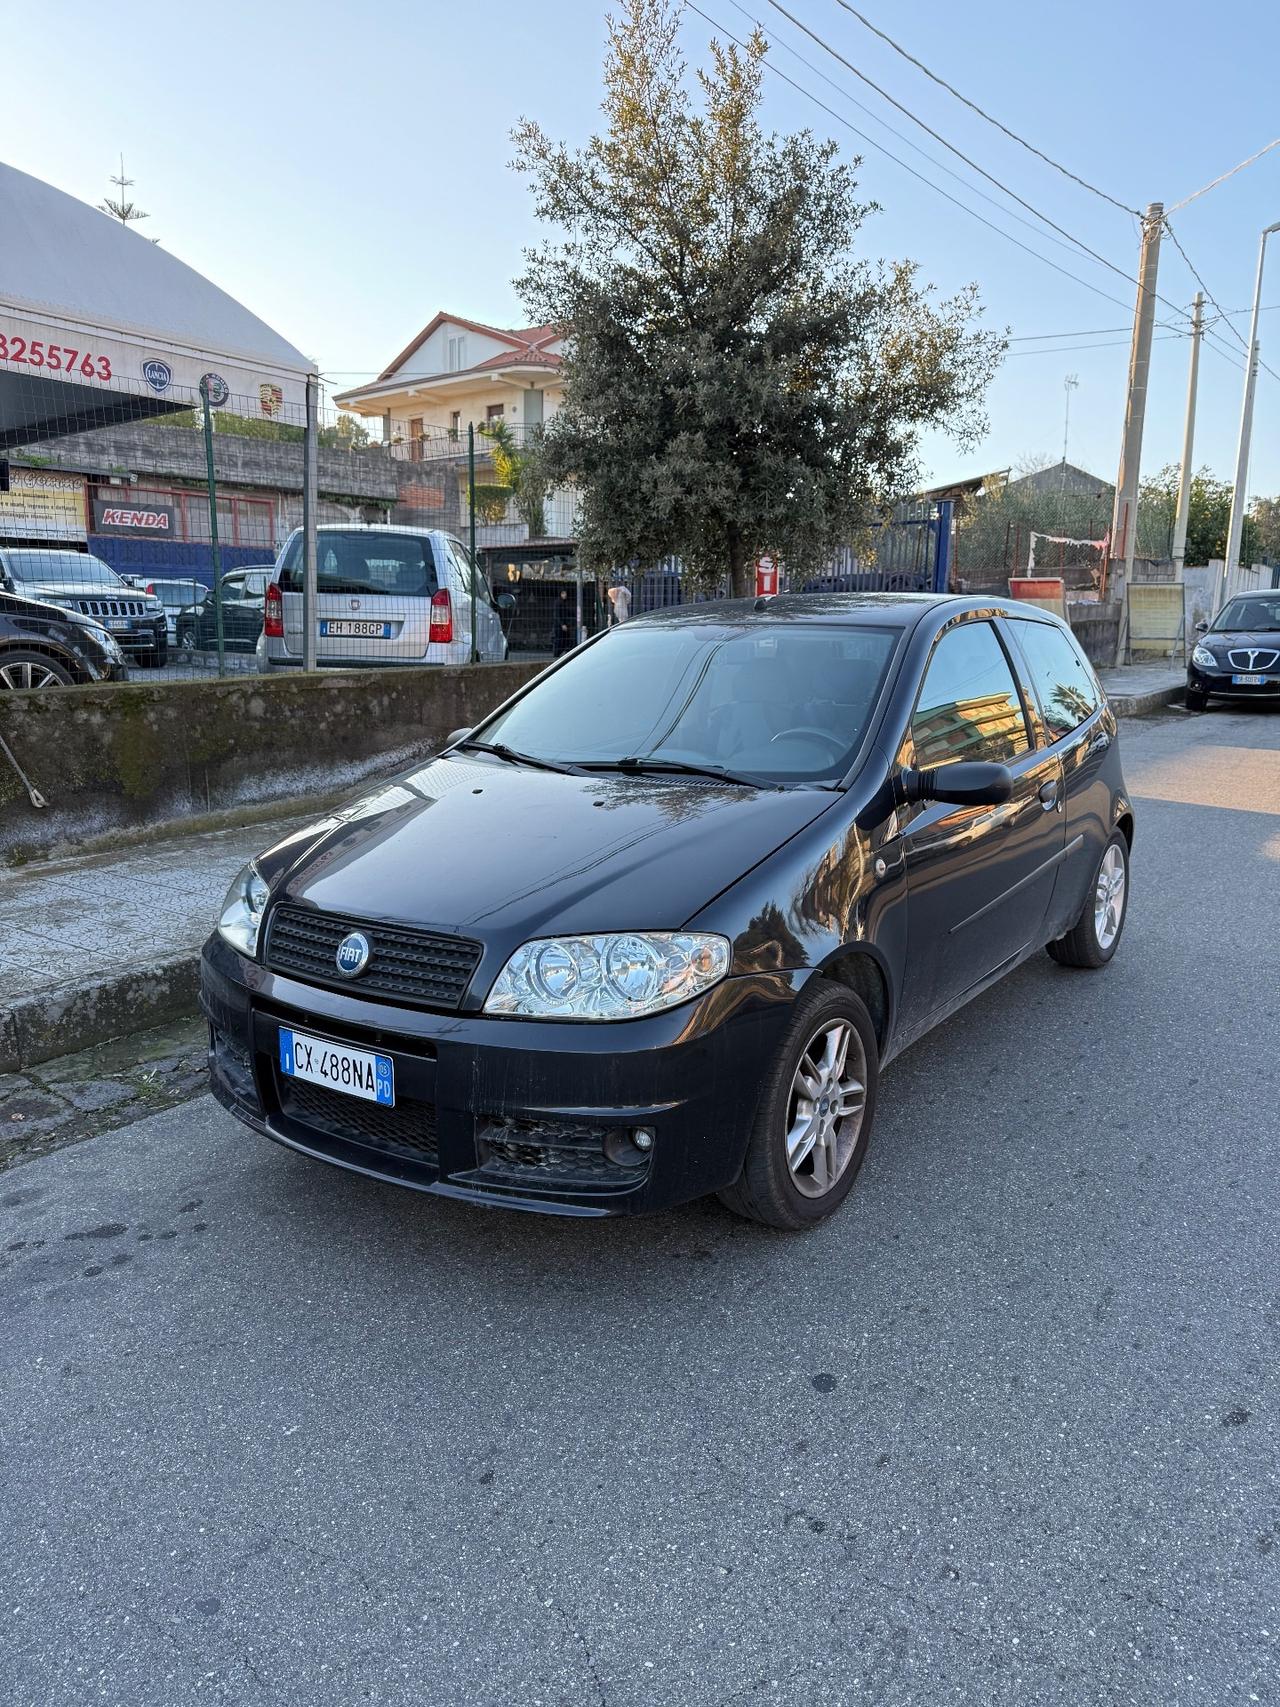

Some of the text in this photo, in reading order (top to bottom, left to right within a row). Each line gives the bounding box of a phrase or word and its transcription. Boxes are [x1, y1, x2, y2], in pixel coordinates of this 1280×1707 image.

[148, 369, 167, 381] LANCIA
[102, 508, 168, 530] KENDA
[329, 622, 343, 634] EH
[347, 623, 383, 635] 188GP
[340, 946, 362, 963] FIAT
[294, 1042, 313, 1074] CX
[320, 1051, 375, 1092] 488NA
[377, 1078, 391, 1099] PD
